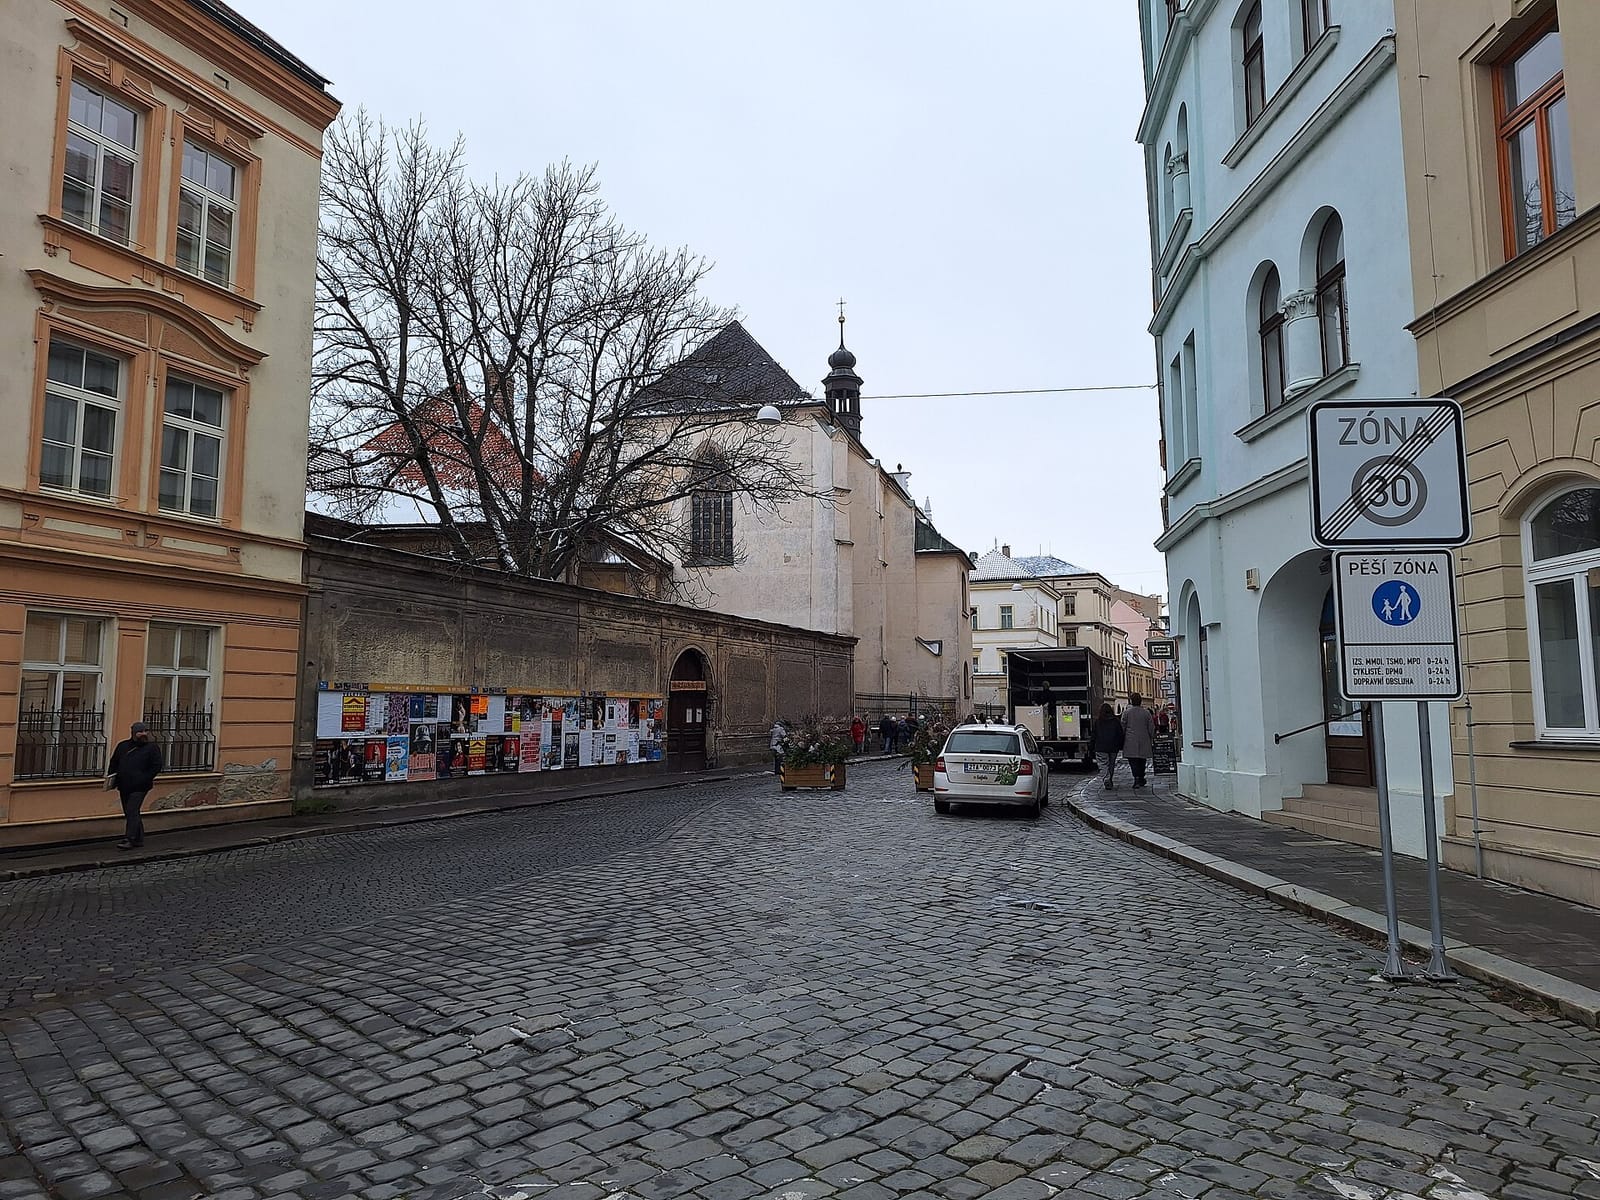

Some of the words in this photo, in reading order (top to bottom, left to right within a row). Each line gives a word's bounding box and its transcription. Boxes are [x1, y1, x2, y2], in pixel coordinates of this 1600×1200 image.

[1338, 410, 1433, 445] ZÓNA
[1368, 474, 1412, 507] 30
[1349, 559, 1387, 575] PĚŠÍ
[1393, 558, 1439, 575] ZÓNA
[1407, 657, 1421, 665] MPO
[1427, 657, 1443, 665] 0-24
[1385, 667, 1403, 675] DPMO
[1427, 667, 1444, 675] 0-24
[1445, 667, 1450, 675] h
[1353, 677, 1384, 685] DOPRAVNÍ
[1385, 677, 1414, 685] OBSLUHA
[1428, 677, 1444, 685] 0-24
[1446, 677, 1451, 685] h
